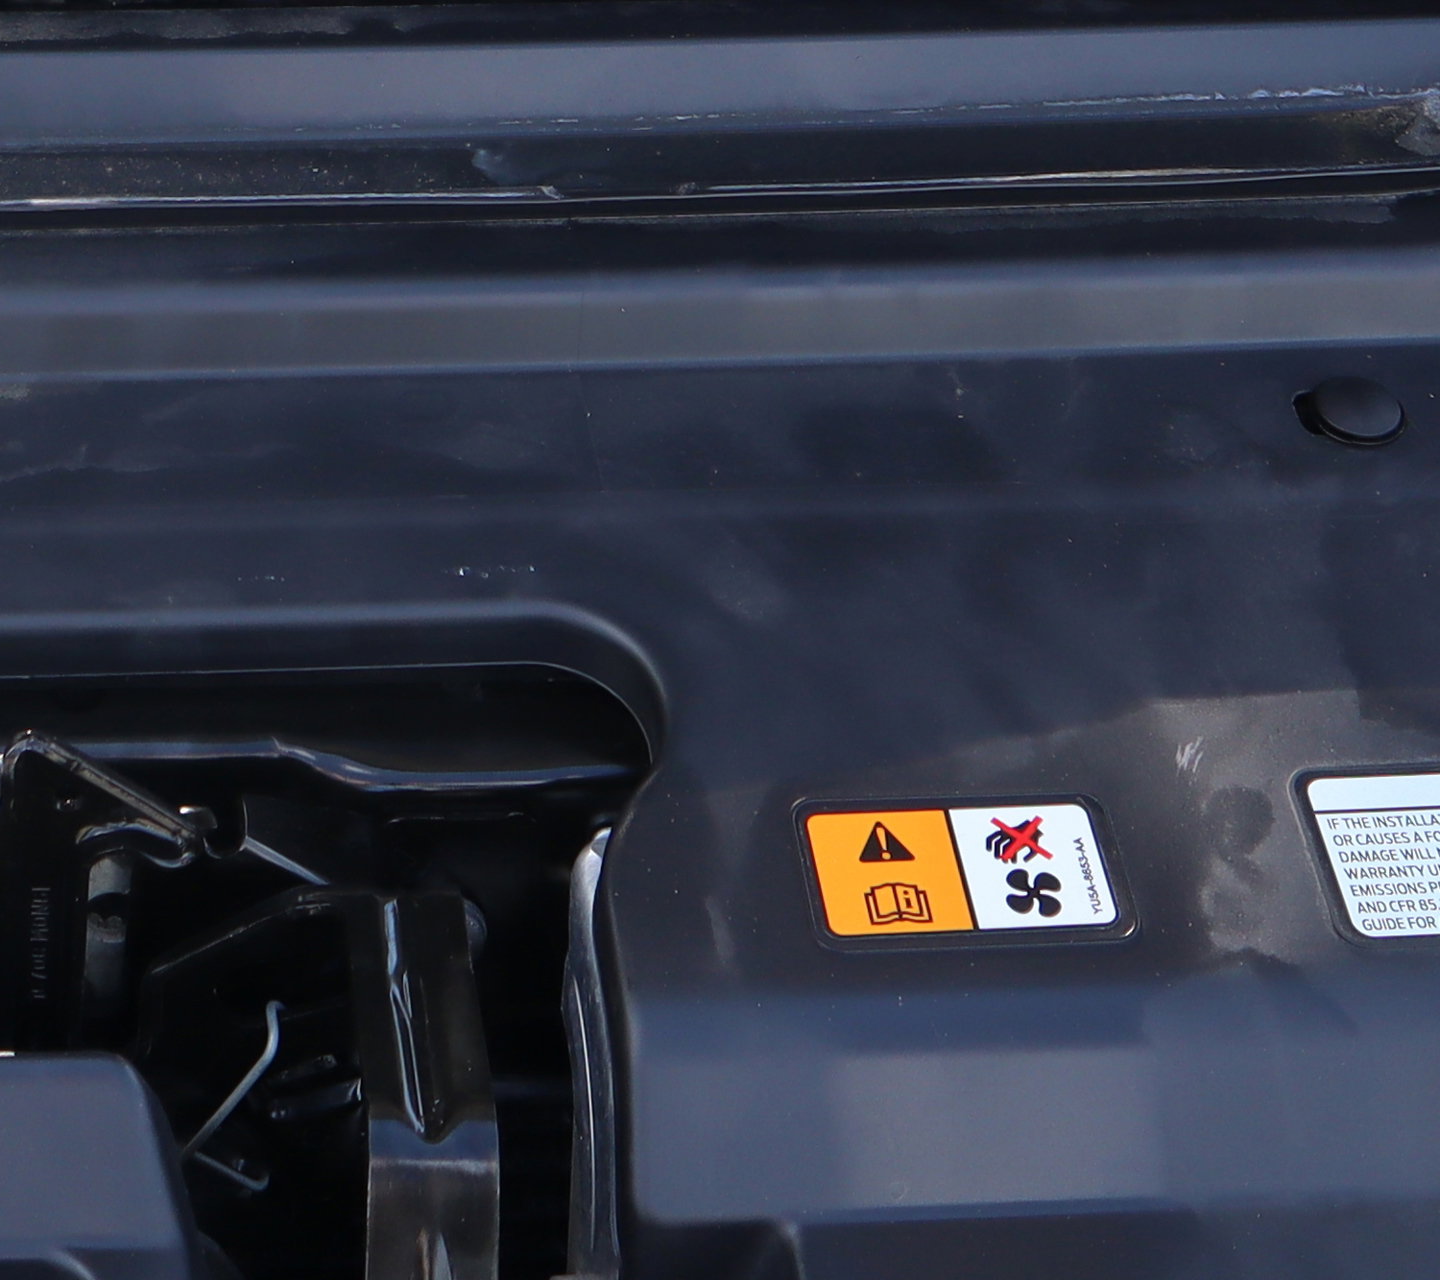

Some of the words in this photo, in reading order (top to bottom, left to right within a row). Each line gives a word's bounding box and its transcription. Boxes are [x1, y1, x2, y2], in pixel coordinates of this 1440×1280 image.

[1326, 818, 1339, 830] IF
[1341, 816, 1372, 830] THE
[1332, 834, 1354, 847] OR
[1355, 831, 1411, 846] CAUSES
[1413, 831, 1425, 843] A
[1338, 849, 1400, 863] DAMAGE
[1399, 847, 1436, 861] WILL
[1343, 865, 1424, 880] WARRANTY
[1349, 881, 1428, 897] EMISSIONS
[1357, 900, 1388, 914] AND
[1388, 899, 1417, 913] CFR
[1361, 917, 1406, 931] GUIDE
[1406, 915, 1437, 929] FOR
